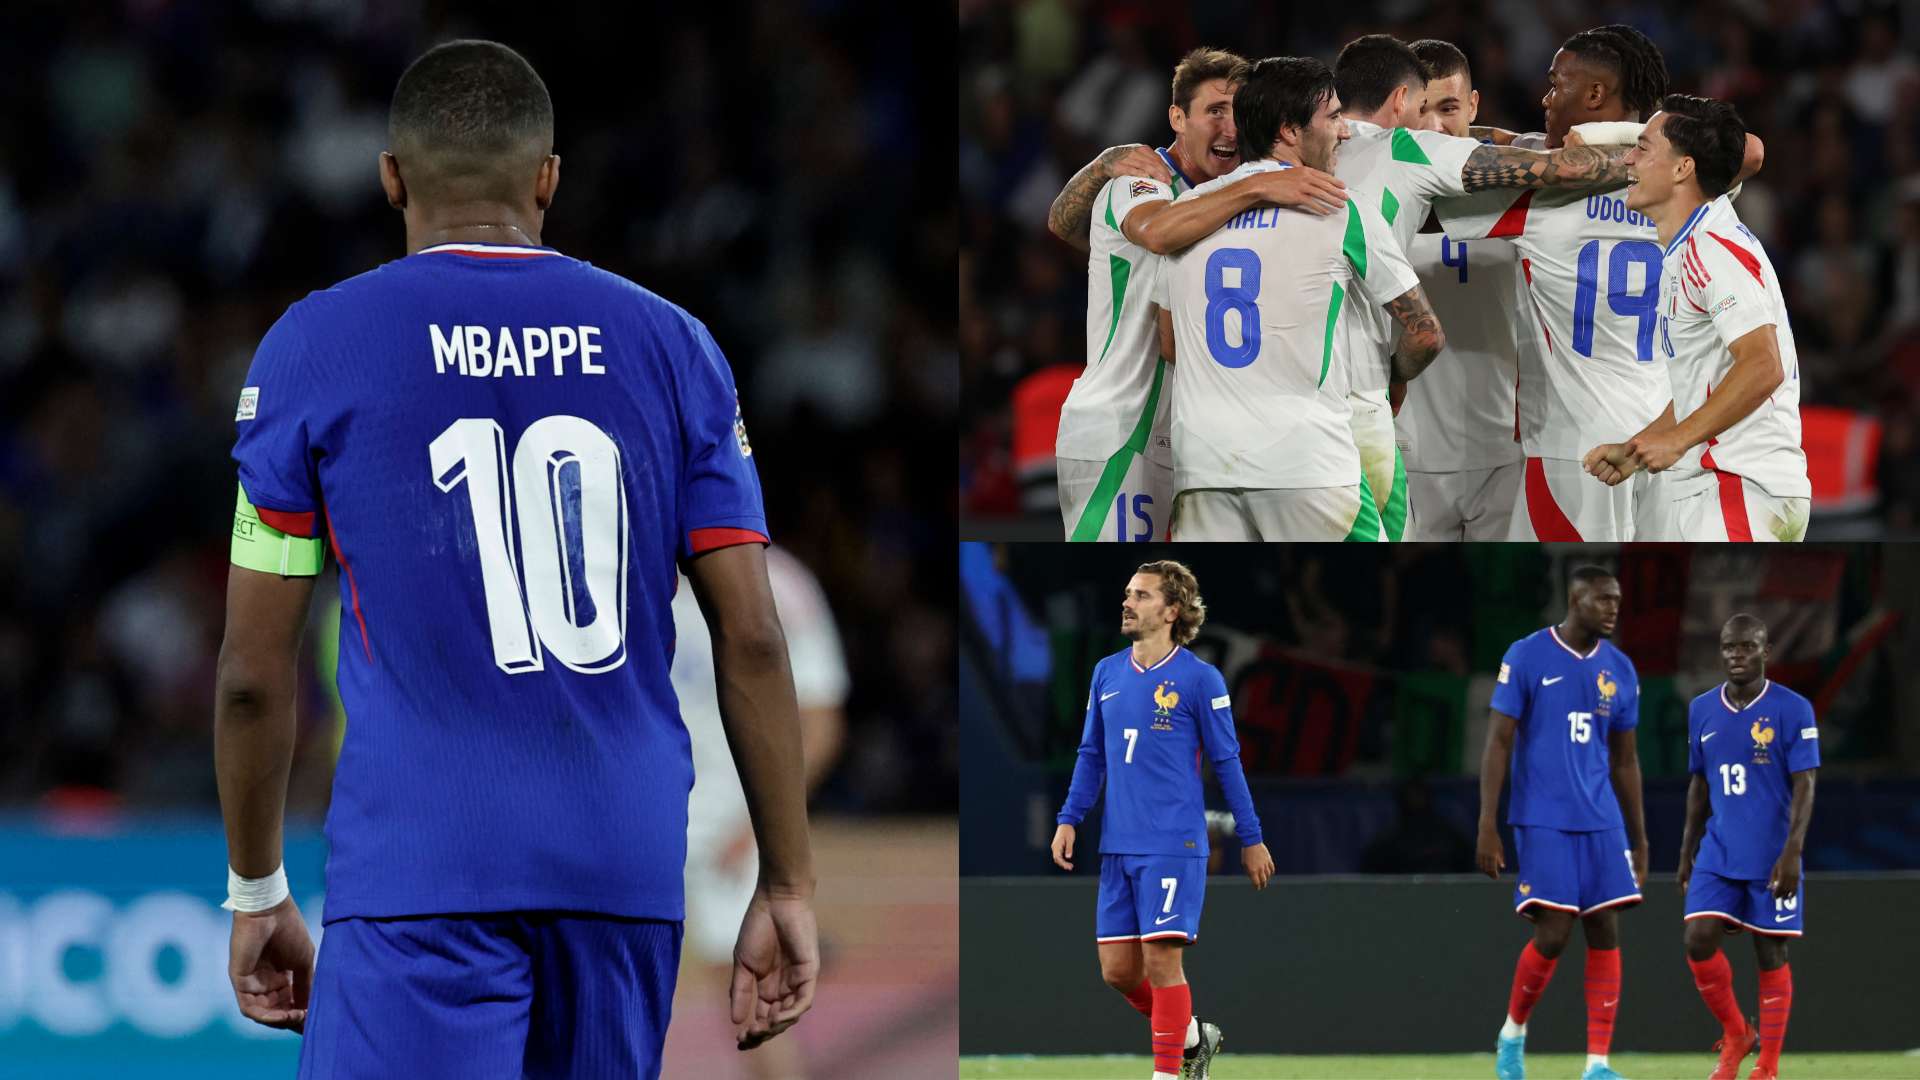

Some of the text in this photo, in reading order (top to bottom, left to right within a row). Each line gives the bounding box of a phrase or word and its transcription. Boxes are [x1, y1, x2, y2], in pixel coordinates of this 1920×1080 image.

[1441, 234, 1467, 284] 4
[1204, 247, 1262, 369] 8
[1572, 240, 1665, 362] 19
[429, 323, 606, 378] MBAPPE
[1116, 492, 1154, 542] 15
[428, 414, 629, 675] 10
[1123, 728, 1139, 764] 7
[1567, 711, 1592, 744] 15
[1719, 763, 1747, 796] 13
[1160, 877, 1178, 914] 7
